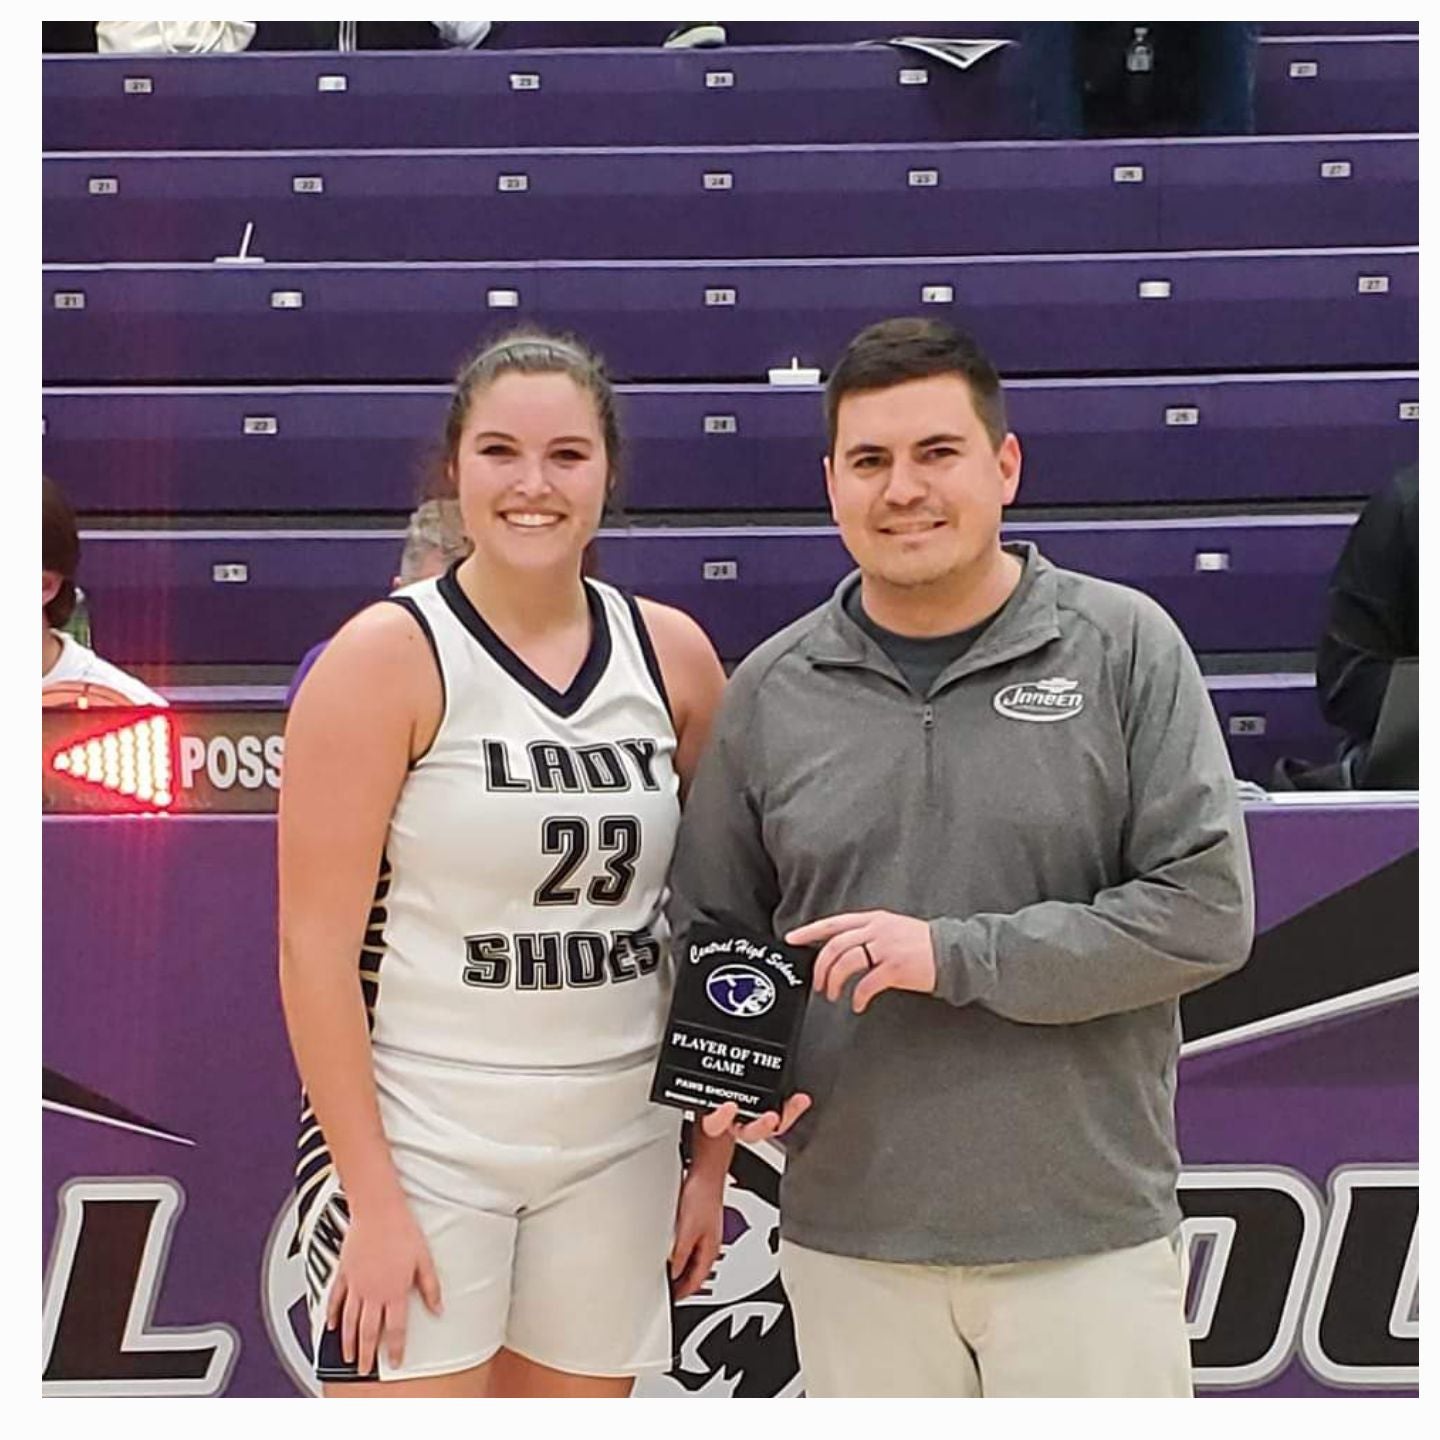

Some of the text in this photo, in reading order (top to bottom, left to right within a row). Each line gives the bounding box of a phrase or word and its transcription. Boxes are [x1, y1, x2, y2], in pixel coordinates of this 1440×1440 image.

[180, 735, 285, 789] POSS
[482, 738, 660, 793] LADY
[533, 815, 642, 906] 23
[462, 930, 661, 990] SHOES
[690, 938, 803, 987] Central High School
[671, 1032, 782, 1070] PLAYER OF THE
[701, 1056, 745, 1076] GAME
